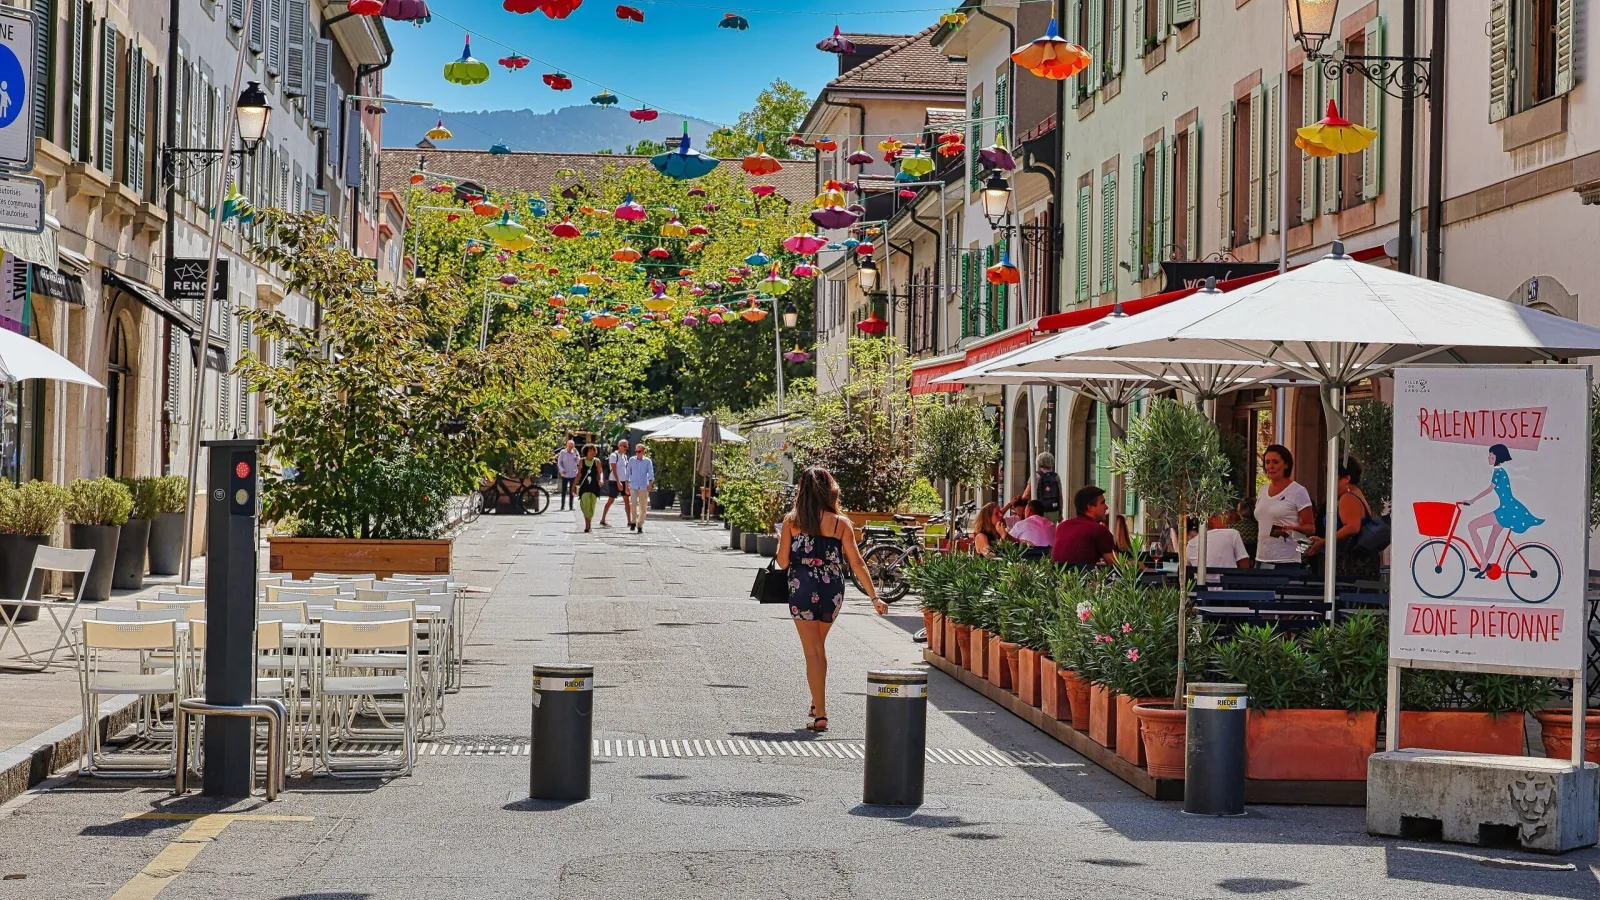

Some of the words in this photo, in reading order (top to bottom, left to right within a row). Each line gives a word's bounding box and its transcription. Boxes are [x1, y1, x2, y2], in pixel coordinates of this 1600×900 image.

[1419, 407, 1560, 441] RALENTISSEZ...
[1411, 607, 1458, 637] ZONE
[1469, 604, 1560, 643] PIÉTONNE
